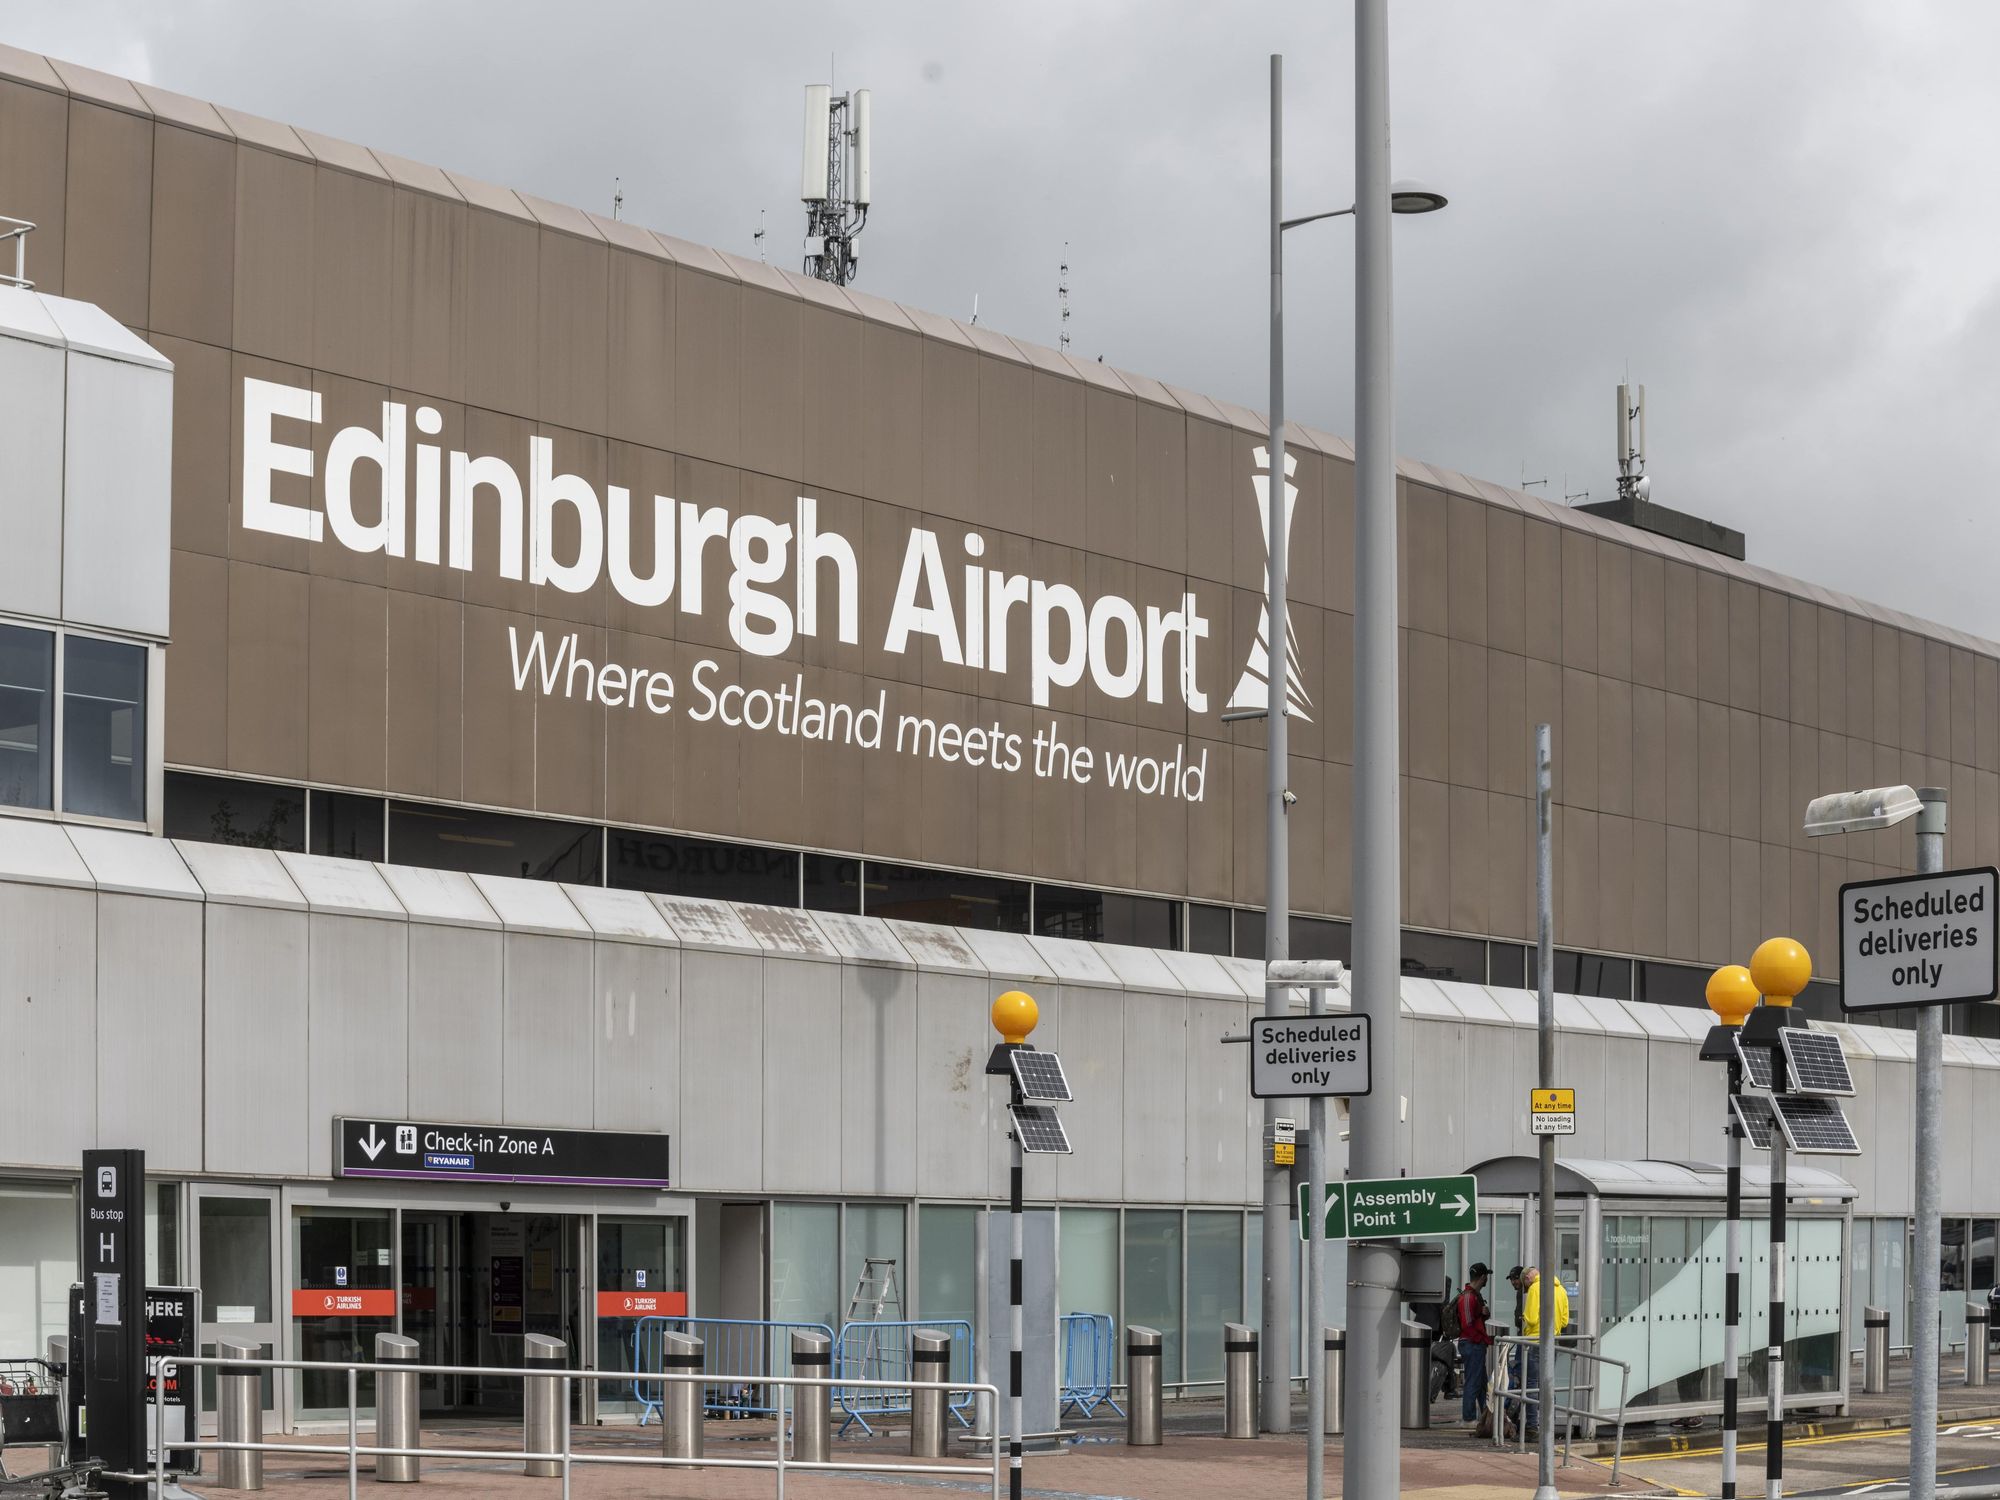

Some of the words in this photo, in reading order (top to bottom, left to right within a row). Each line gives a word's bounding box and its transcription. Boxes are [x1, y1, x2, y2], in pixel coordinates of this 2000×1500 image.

[243, 377, 858, 657] Edinburgh
[884, 527, 1209, 713] Airport
[508, 626, 675, 714] Where
[688, 659, 886, 750] Scotland
[896, 718, 1022, 772] meets
[1033, 721, 1094, 784] the
[1105, 743, 1207, 803] world
[1854, 885, 1984, 924] Scheduled
[1859, 923, 1978, 957] deliveries
[1892, 958, 1943, 988] only
[1262, 1024, 1361, 1043] Scheduled
[1266, 1047, 1356, 1064] deliveries
[1291, 1067, 1330, 1086] only
[1548, 1115, 1571, 1123] loading
[424, 1131, 493, 1153] Check-in
[498, 1135, 537, 1155] Zone
[542, 1137, 554, 1155] A
[433, 1156, 470, 1166] RYANAIR
[1353, 1189, 1436, 1207] Assembly
[90, 1207, 105, 1220] Bus
[106, 1209, 124, 1222] stop
[1353, 1211, 1396, 1227] Point
[1402, 1210, 1411, 1225] 1
[100, 1232, 114, 1262] H
